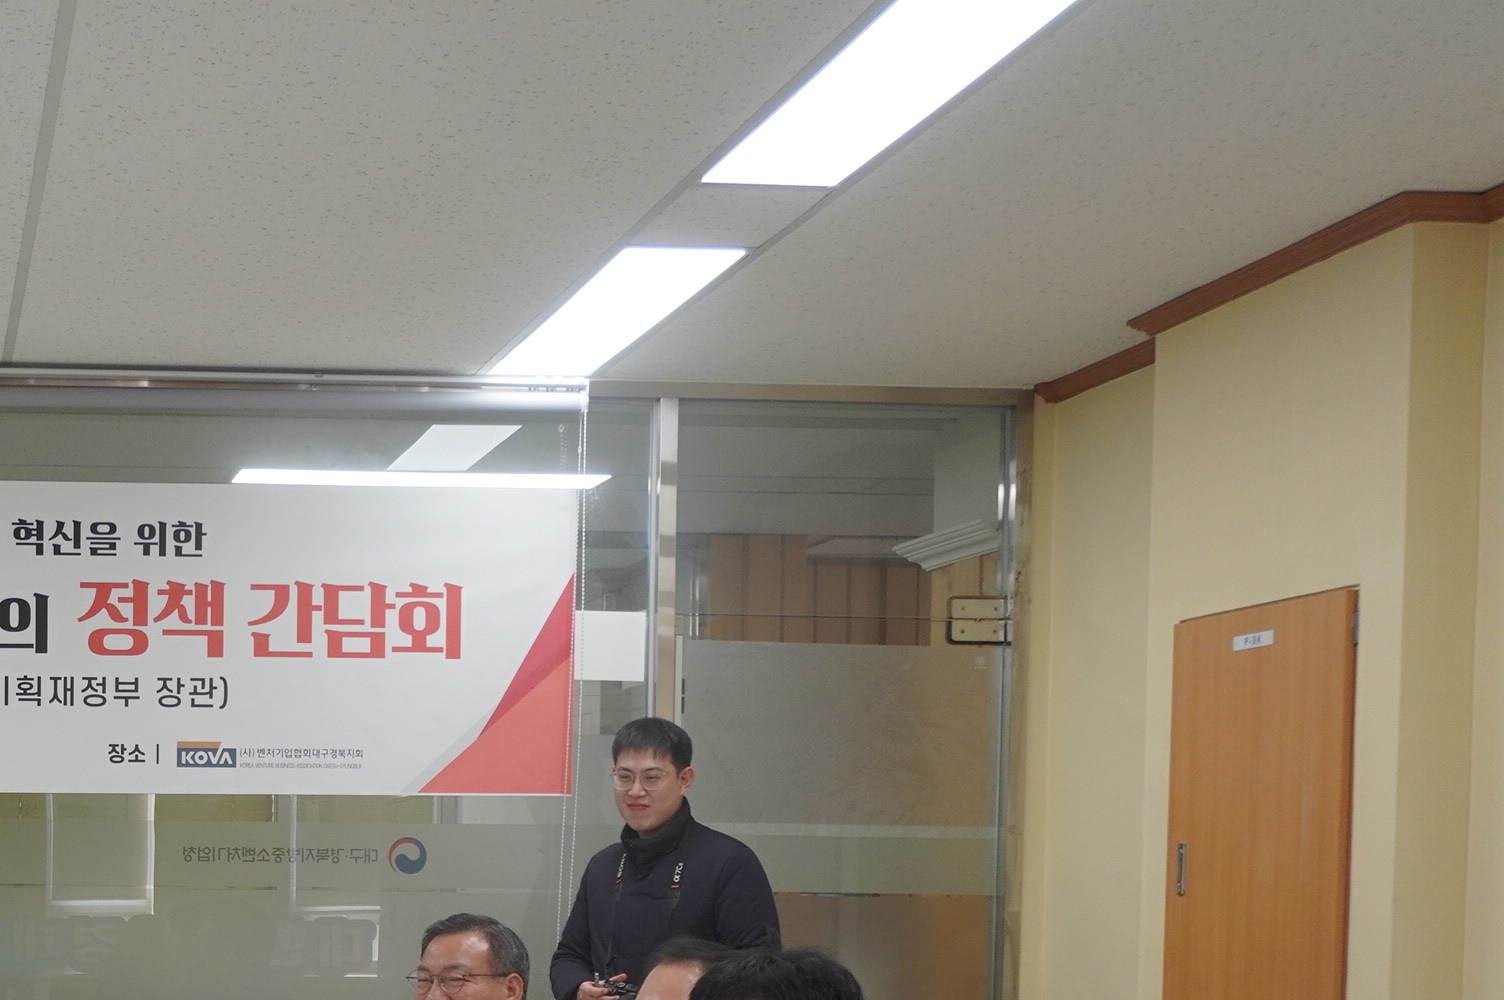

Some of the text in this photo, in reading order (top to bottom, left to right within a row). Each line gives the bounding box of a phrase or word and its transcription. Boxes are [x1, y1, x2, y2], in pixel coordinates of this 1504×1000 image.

[11, 518, 122, 557] 혁신을
[133, 520, 208, 558] 위한
[77, 578, 226, 658] 정책
[246, 580, 464, 660] 간담회
[156, 676, 229, 710] 장관)
[107, 743, 146, 764] 장소
[181, 749, 233, 765] KOVA
[239, 747, 255, 759] (사)
